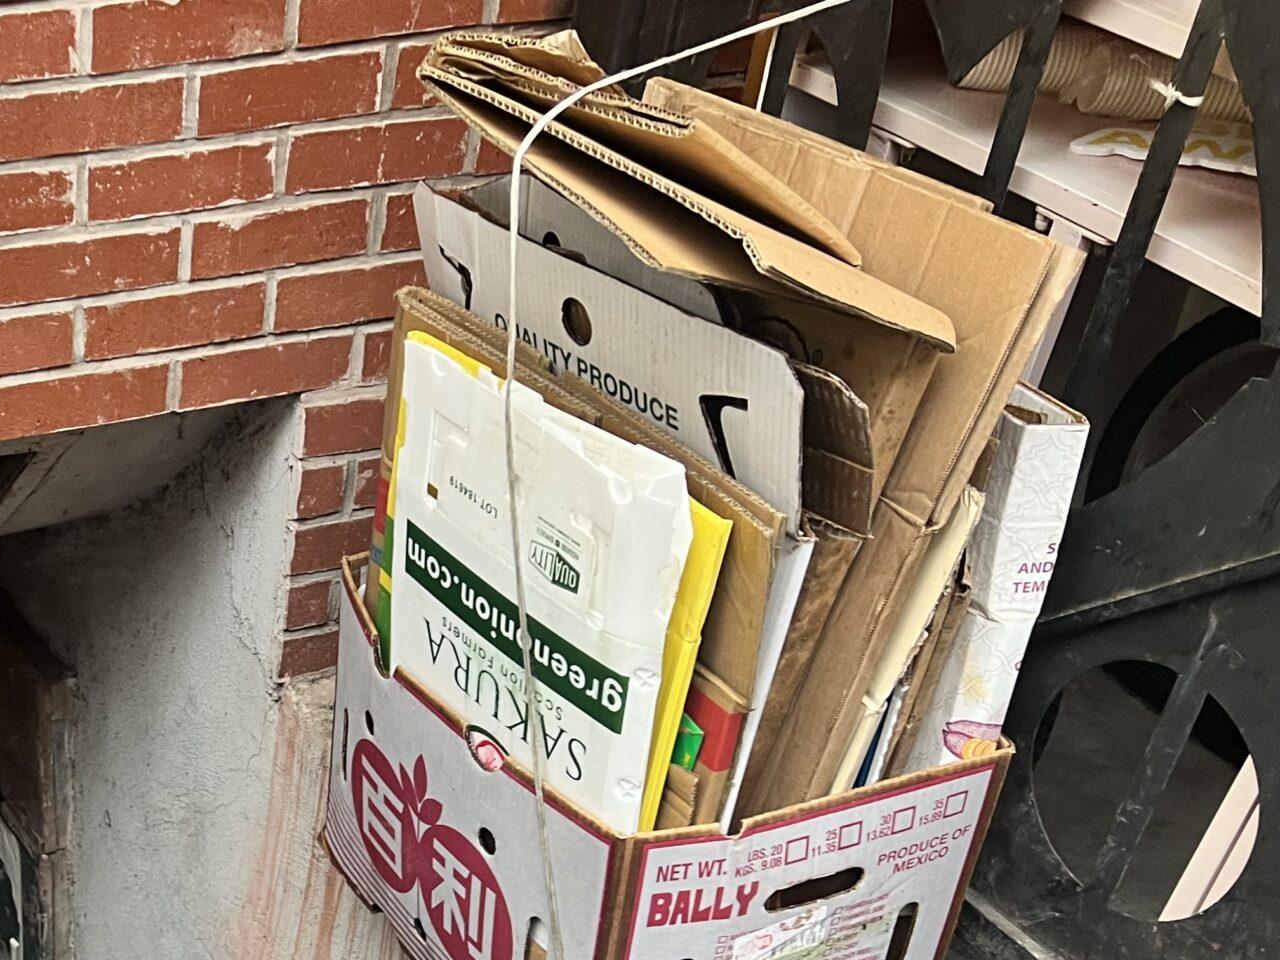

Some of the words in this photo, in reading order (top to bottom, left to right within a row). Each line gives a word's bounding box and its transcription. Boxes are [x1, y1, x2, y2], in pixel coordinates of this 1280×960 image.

[577, 361, 680, 431] PRODUCE
[530, 545, 578, 590] QUALITY
[1017, 561, 1054, 575] AND
[407, 536, 624, 713] greenonion.com
[441, 616, 495, 669] Farmers
[423, 616, 587, 782] SAKURA
[500, 660, 564, 721] Scalion
[866, 826, 892, 843] 13.62
[879, 814, 892, 827] 30
[811, 840, 836, 858] 11.35
[825, 830, 838, 842] 25
[877, 832, 948, 866] PRODUCE
[952, 824, 972, 842] OF
[747, 847, 769, 863] LBS.
[771, 844, 783, 858] 20
[761, 856, 783, 873] 9.08
[892, 846, 949, 875] MEXICO
[656, 863, 693, 883] NET
[698, 858, 727, 879] WT.
[646, 881, 760, 928] BALLY
